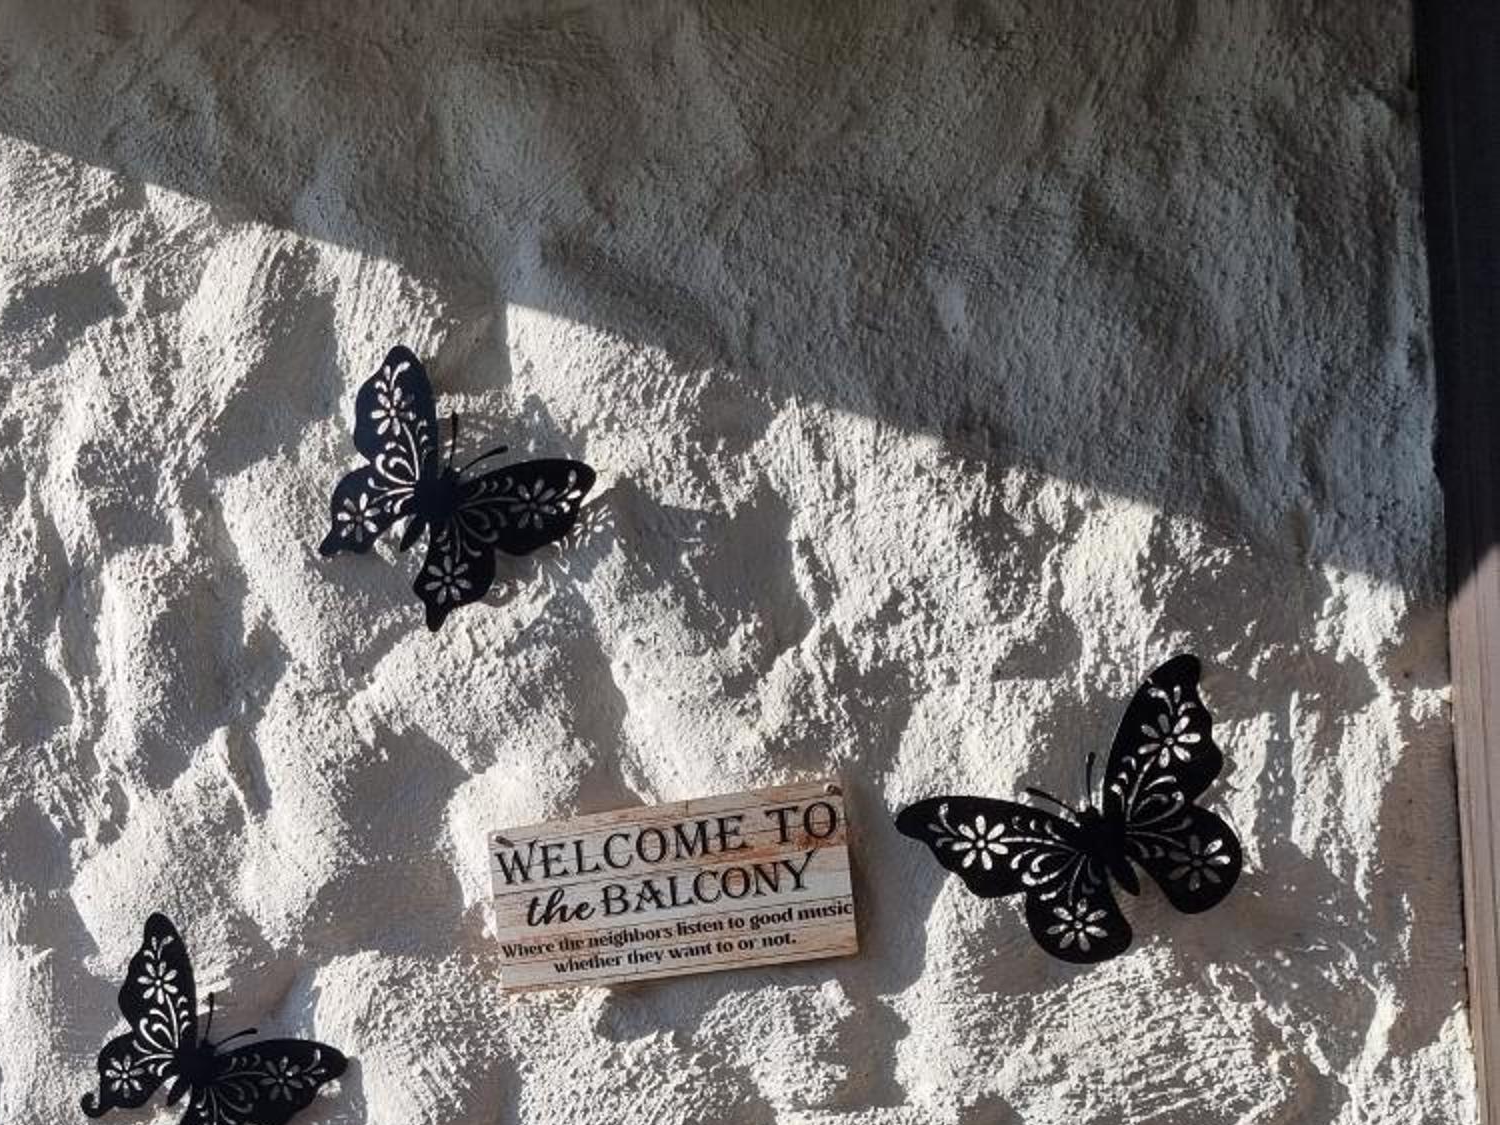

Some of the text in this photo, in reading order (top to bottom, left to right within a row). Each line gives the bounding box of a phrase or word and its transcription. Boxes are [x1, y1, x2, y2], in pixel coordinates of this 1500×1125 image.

[494, 801, 838, 886] WELCOME TO
[527, 848, 819, 927] the BALCONY
[501, 902, 852, 959] Where the neighbors listen to good music
[553, 931, 797, 974] whether they want to or not.
